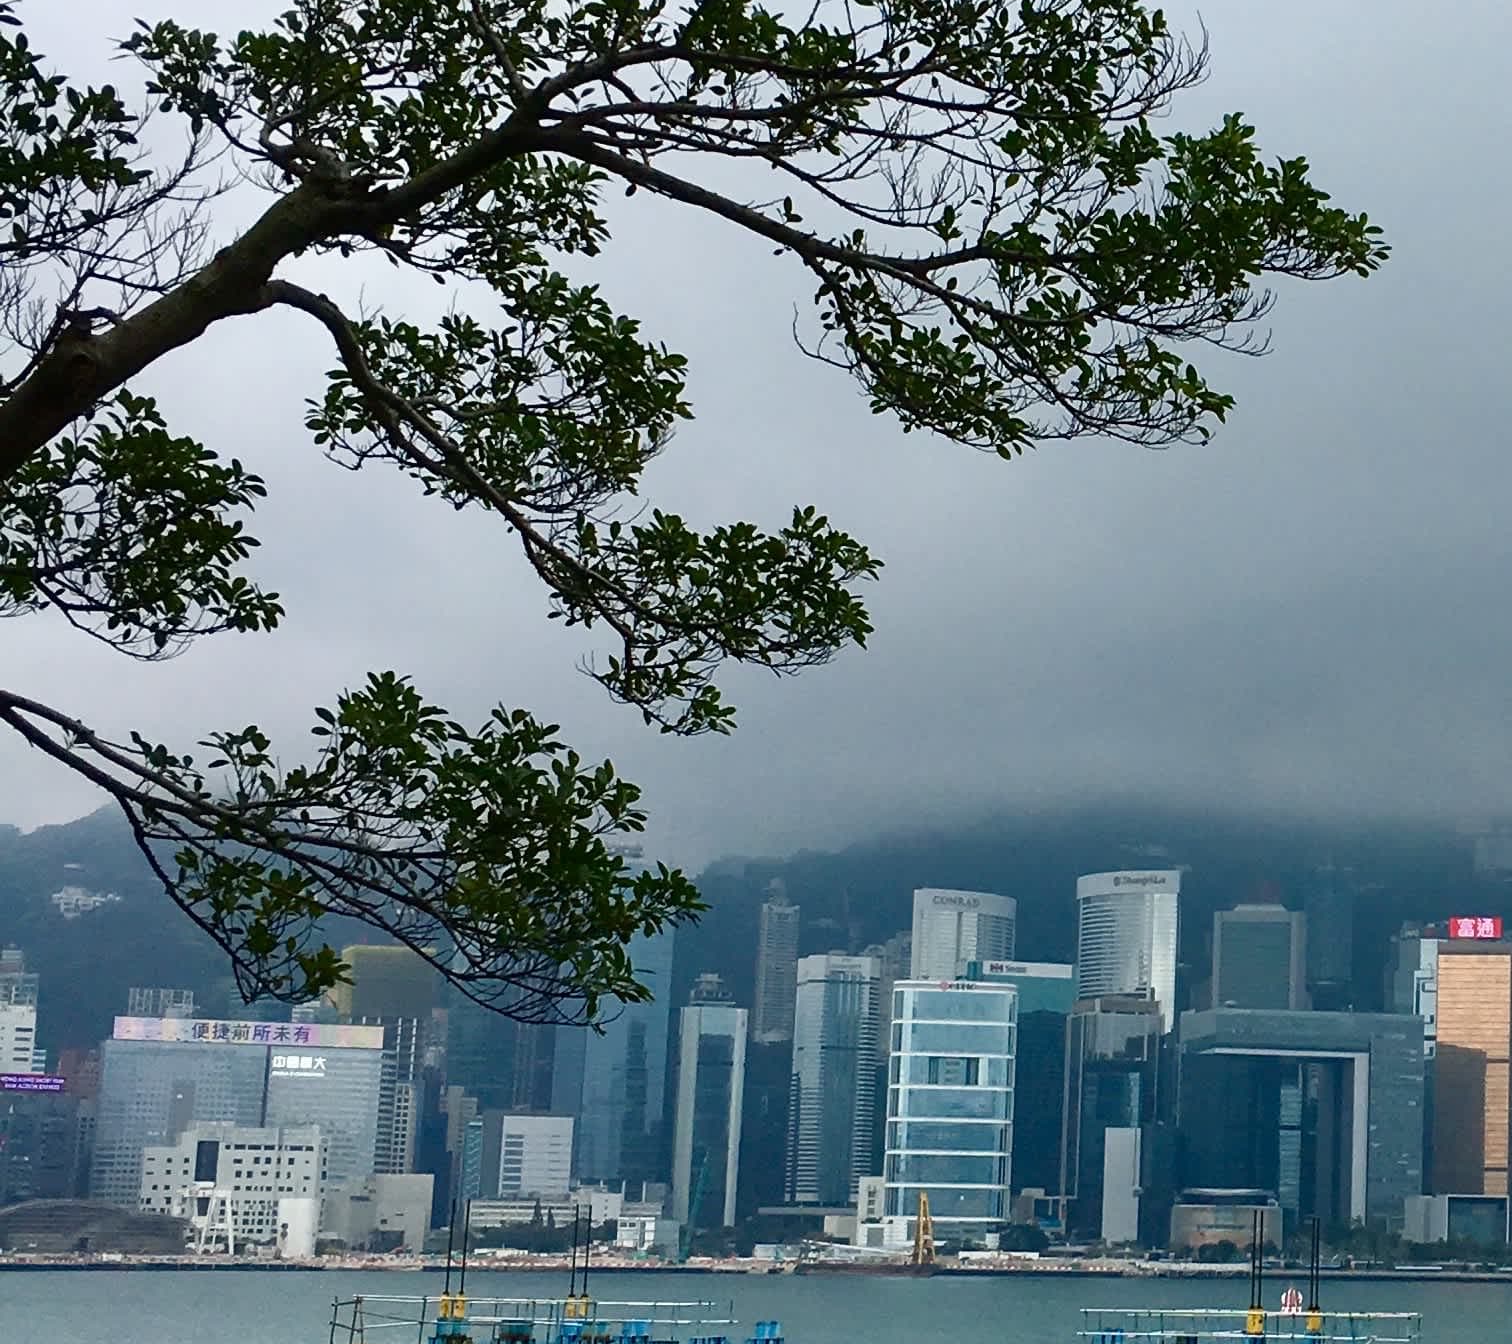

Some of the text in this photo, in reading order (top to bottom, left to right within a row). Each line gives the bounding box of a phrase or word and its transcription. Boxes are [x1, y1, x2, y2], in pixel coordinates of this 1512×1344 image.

[932, 895, 980, 908] CONRAD
[191, 1021, 313, 1044] 便捷前所未有
